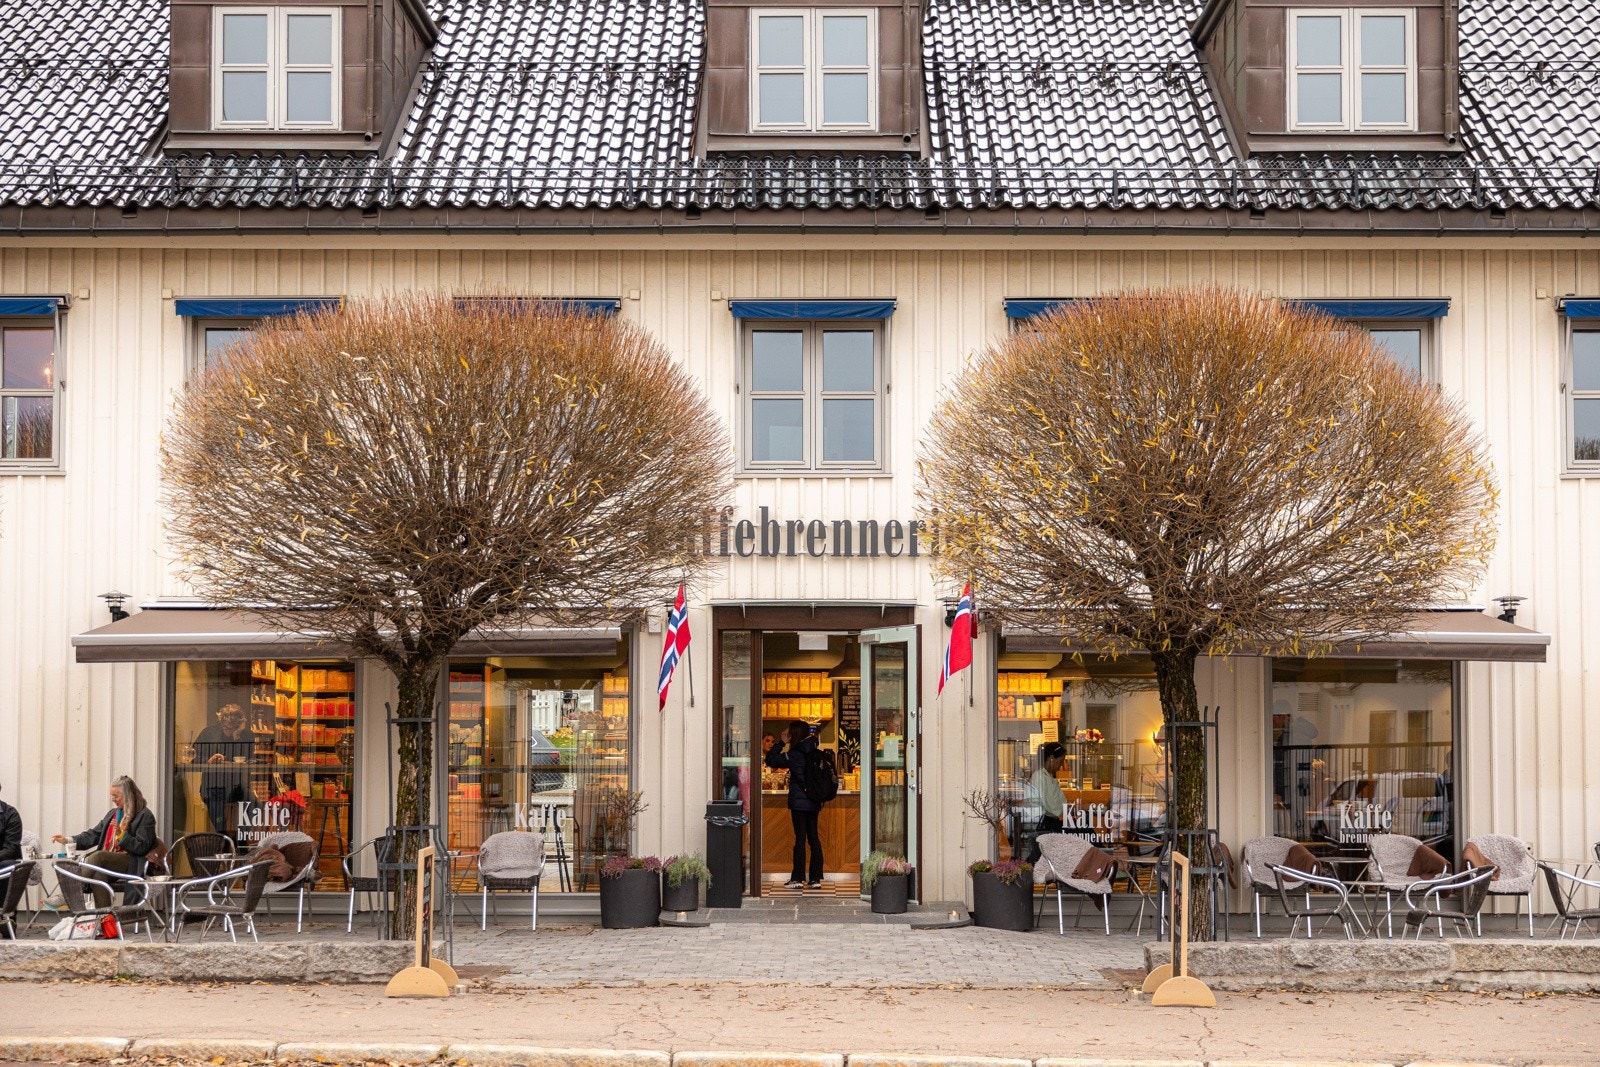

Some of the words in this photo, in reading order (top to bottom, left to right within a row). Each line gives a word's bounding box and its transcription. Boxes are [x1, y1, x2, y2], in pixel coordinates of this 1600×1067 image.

[237, 801, 291, 827] Kaffe
[514, 802, 567, 828] Kaffe
[1061, 803, 1115, 829] Kaffe
[1340, 803, 1392, 829] Kaffe
[237, 828, 290, 841] brenn
[1339, 830, 1392, 844] brenn
